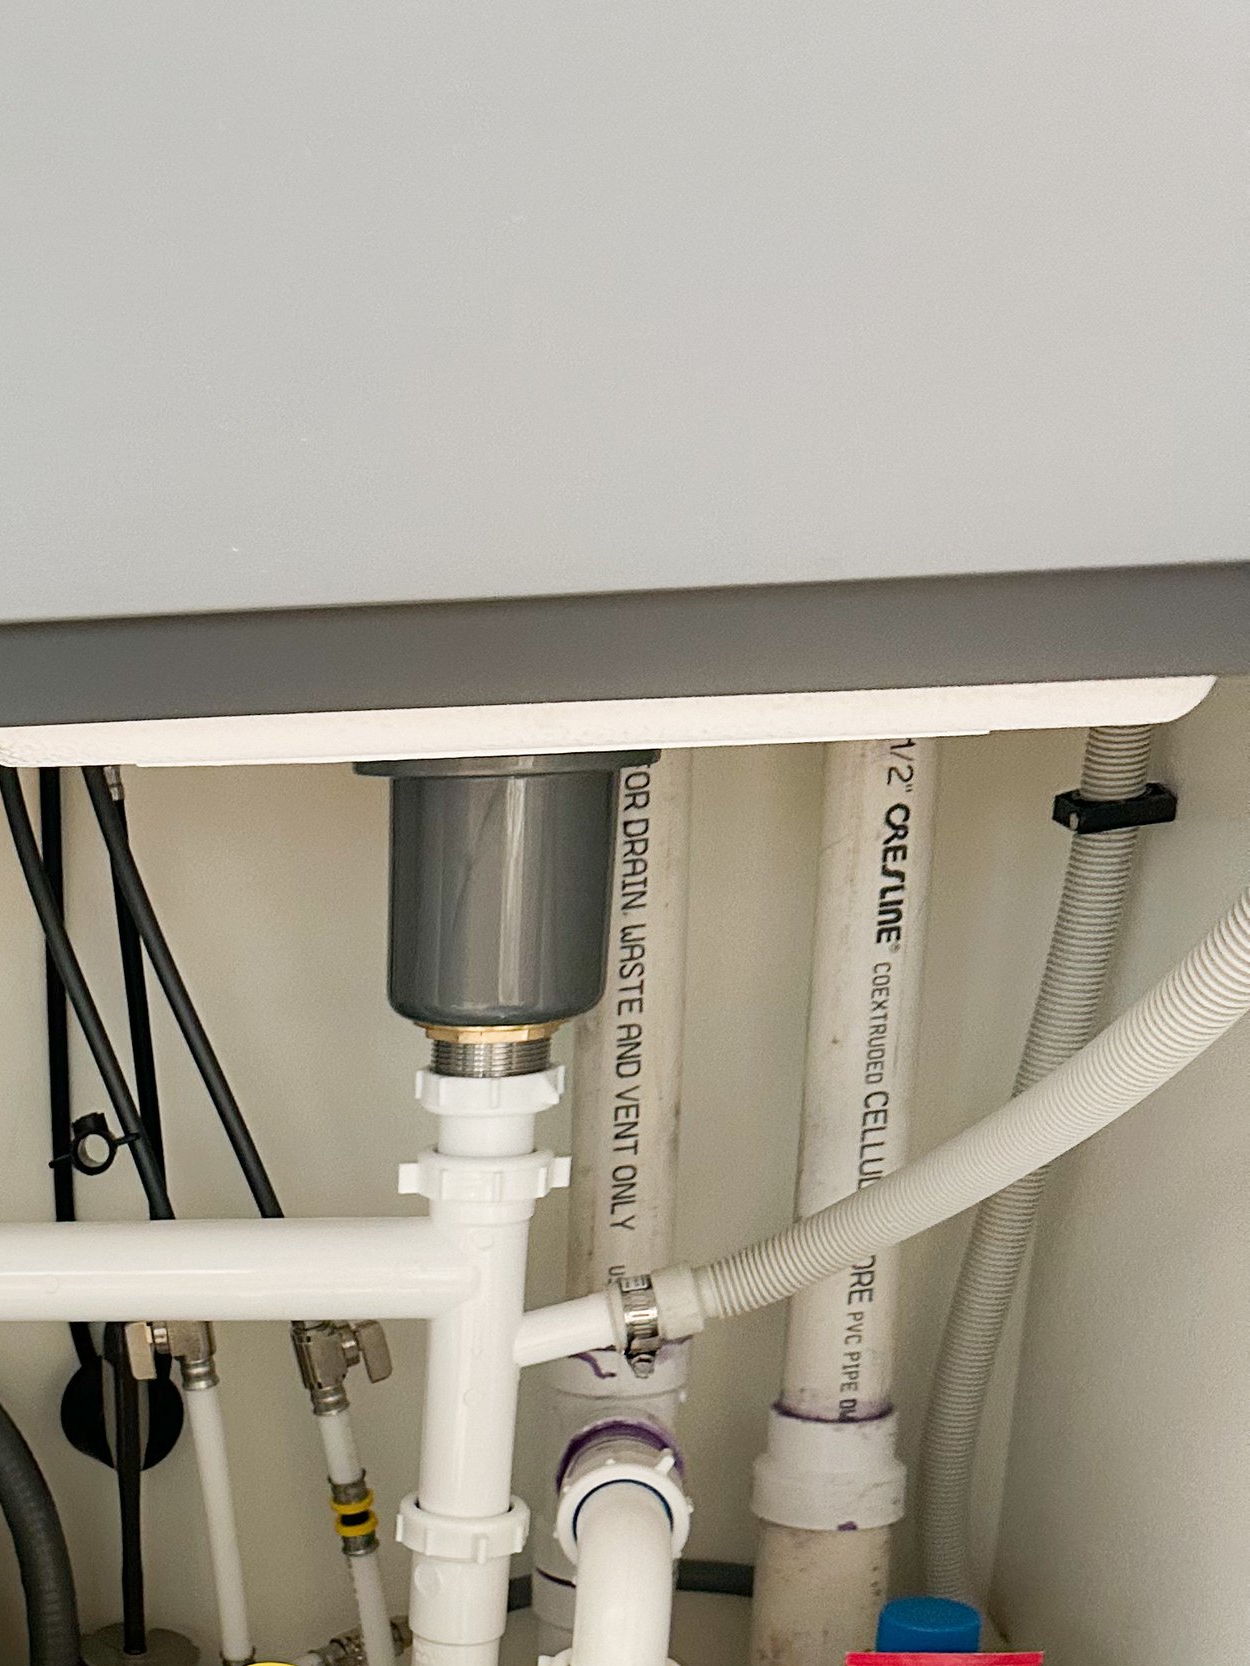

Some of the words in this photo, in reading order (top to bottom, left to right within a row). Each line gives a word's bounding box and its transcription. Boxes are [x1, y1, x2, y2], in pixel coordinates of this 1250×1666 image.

[623, 764, 650, 811] OR
[617, 923, 646, 1017] WASTE
[616, 1023, 643, 1079] AND
[864, 961, 891, 1085] COEXTRUDED
[613, 1085, 640, 1155] VENT
[858, 1090, 890, 1191] CELLUL
[610, 1165, 638, 1230] ONLY
[844, 1311, 865, 1345] PVC
[839, 1351, 860, 1393] PIPE
